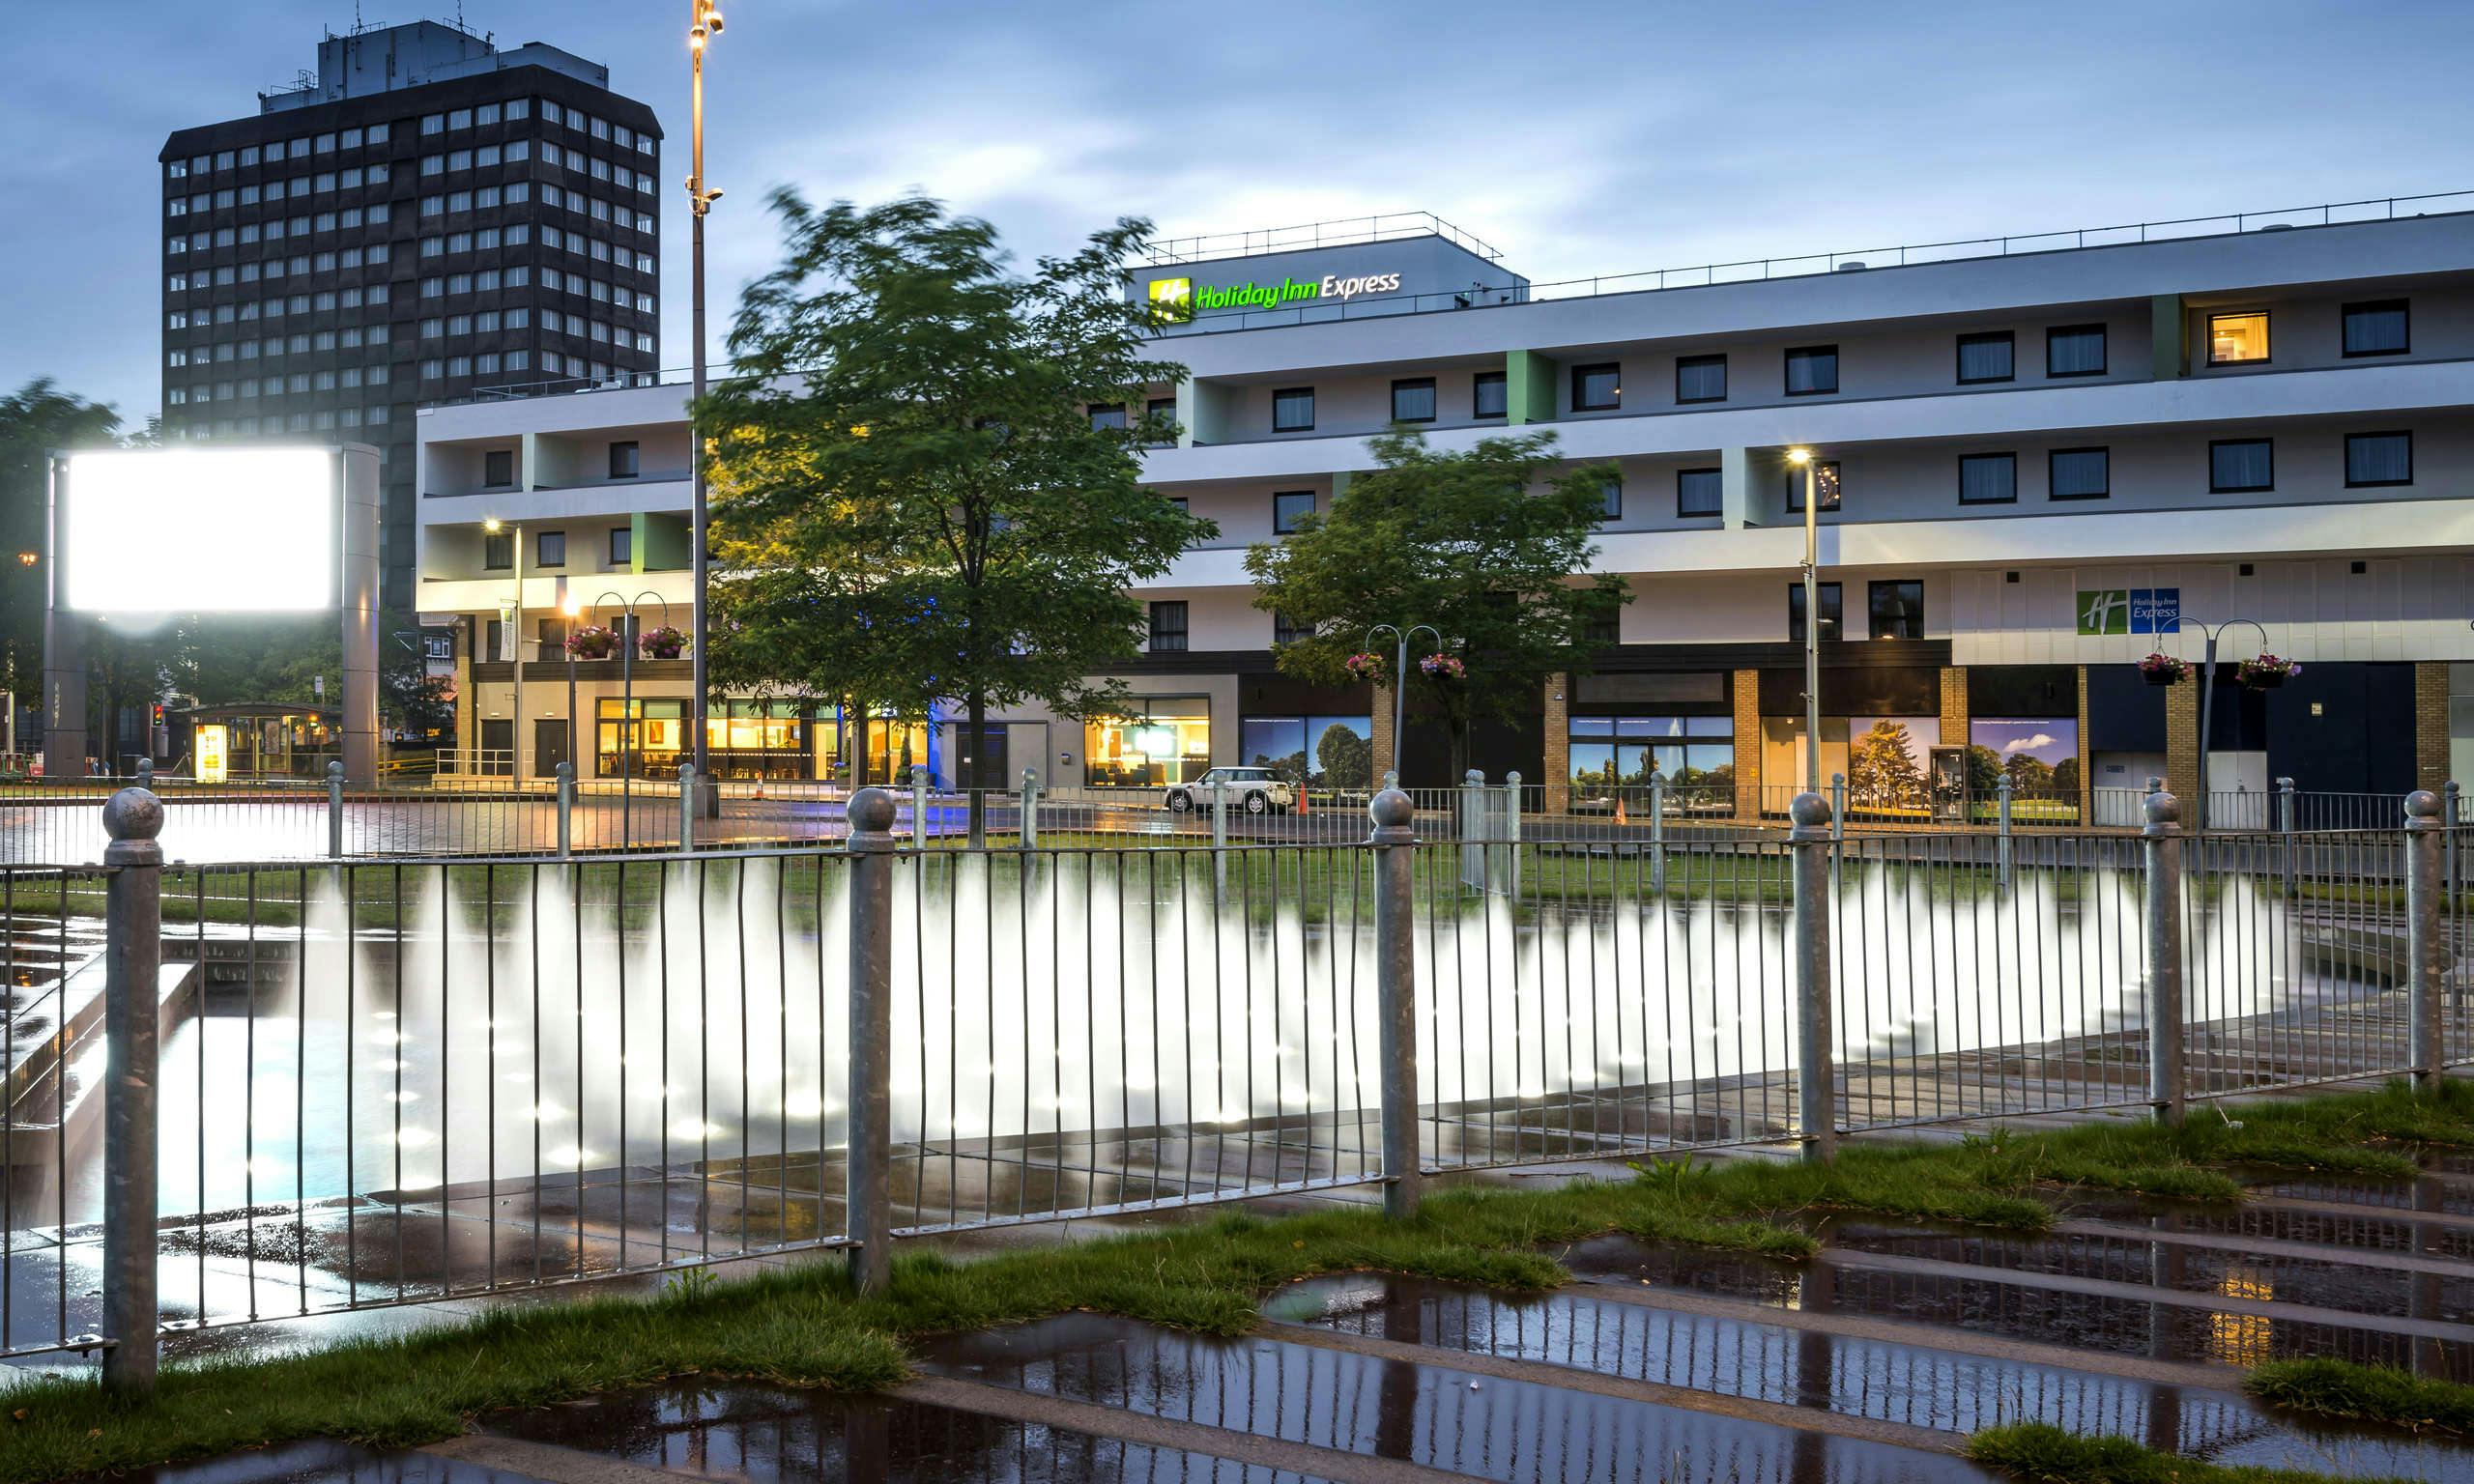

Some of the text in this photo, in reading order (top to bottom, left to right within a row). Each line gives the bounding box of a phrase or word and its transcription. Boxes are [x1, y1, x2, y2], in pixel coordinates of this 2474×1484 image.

[1195, 273, 1400, 309] Holiday Inn Express
[2164, 597, 2177, 606] Inn
[2134, 607, 2177, 619] Express
